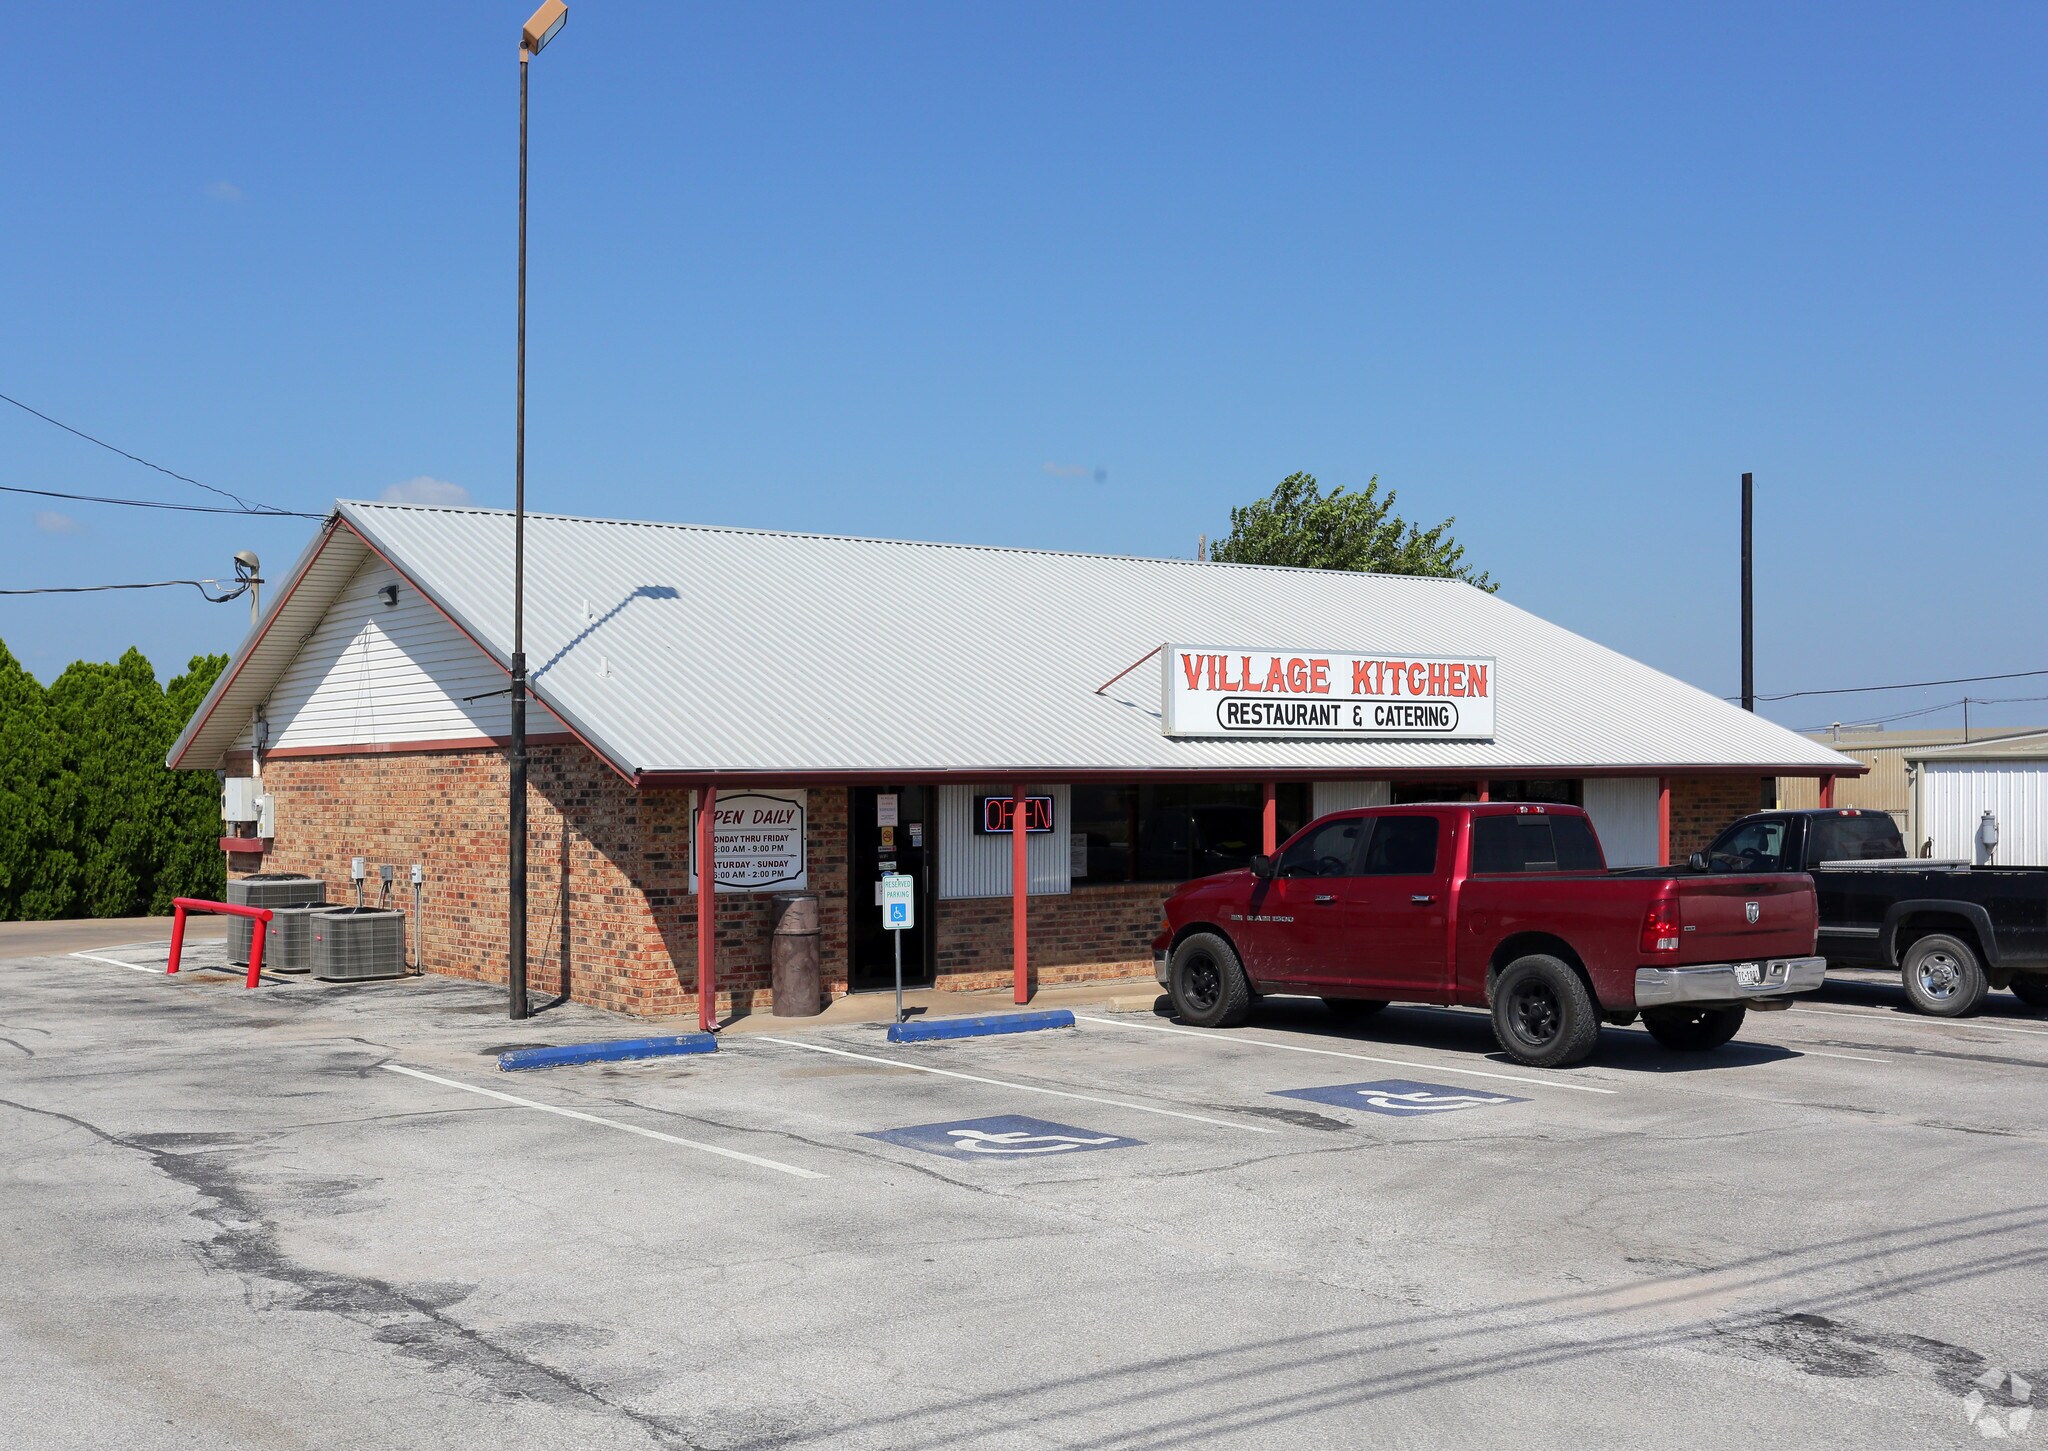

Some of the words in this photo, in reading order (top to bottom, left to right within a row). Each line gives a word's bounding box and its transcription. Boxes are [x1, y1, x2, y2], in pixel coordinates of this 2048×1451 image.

[1180, 653, 1331, 695] VILLAGE
[1351, 659, 1489, 698] KITCHEN
[1227, 703, 1342, 727] RESTAURANT
[1352, 705, 1363, 728] &
[1374, 705, 1450, 727] CATERING
[714, 809, 745, 825] PEN
[752, 809, 795, 825] DAILY
[714, 835, 739, 844] ONDAY
[740, 835, 761, 843] THRU
[763, 834, 790, 842] FRIDAY
[732, 845, 746, 853] AM
[752, 844, 770, 852] 9:00
[771, 844, 784, 852] PM
[714, 861, 751, 869] ATURDAY
[757, 860, 789, 868] SUNDAY
[732, 871, 746, 879] AM
[752, 870, 770, 878] 2:00
[771, 870, 784, 878] PM
[885, 880, 911, 888] RESERVED
[886, 890, 910, 898] PARKING
